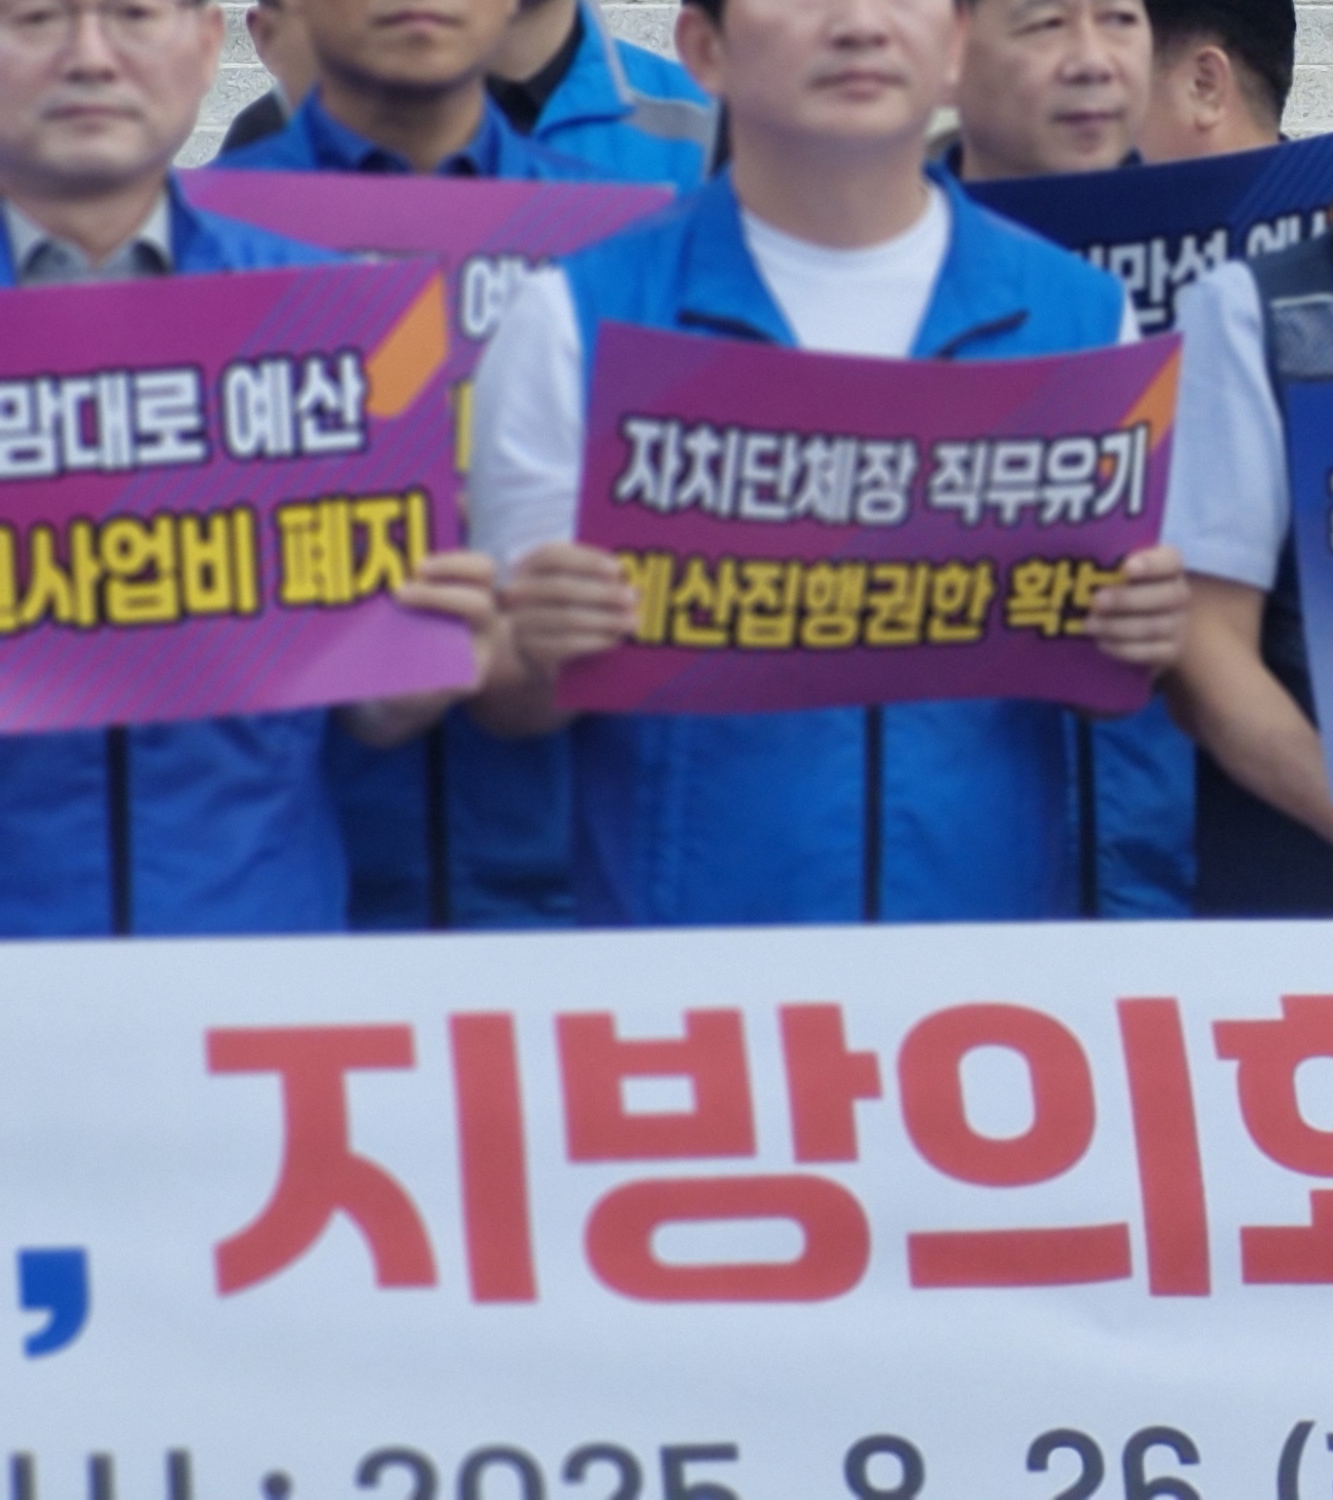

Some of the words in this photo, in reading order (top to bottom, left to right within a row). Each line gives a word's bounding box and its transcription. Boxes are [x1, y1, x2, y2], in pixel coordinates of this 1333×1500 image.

[223, 352, 367, 457] 예산
[616, 418, 918, 525] 자치단체장
[928, 423, 1145, 526] 직무유기
[278, 492, 428, 605] 폐지
